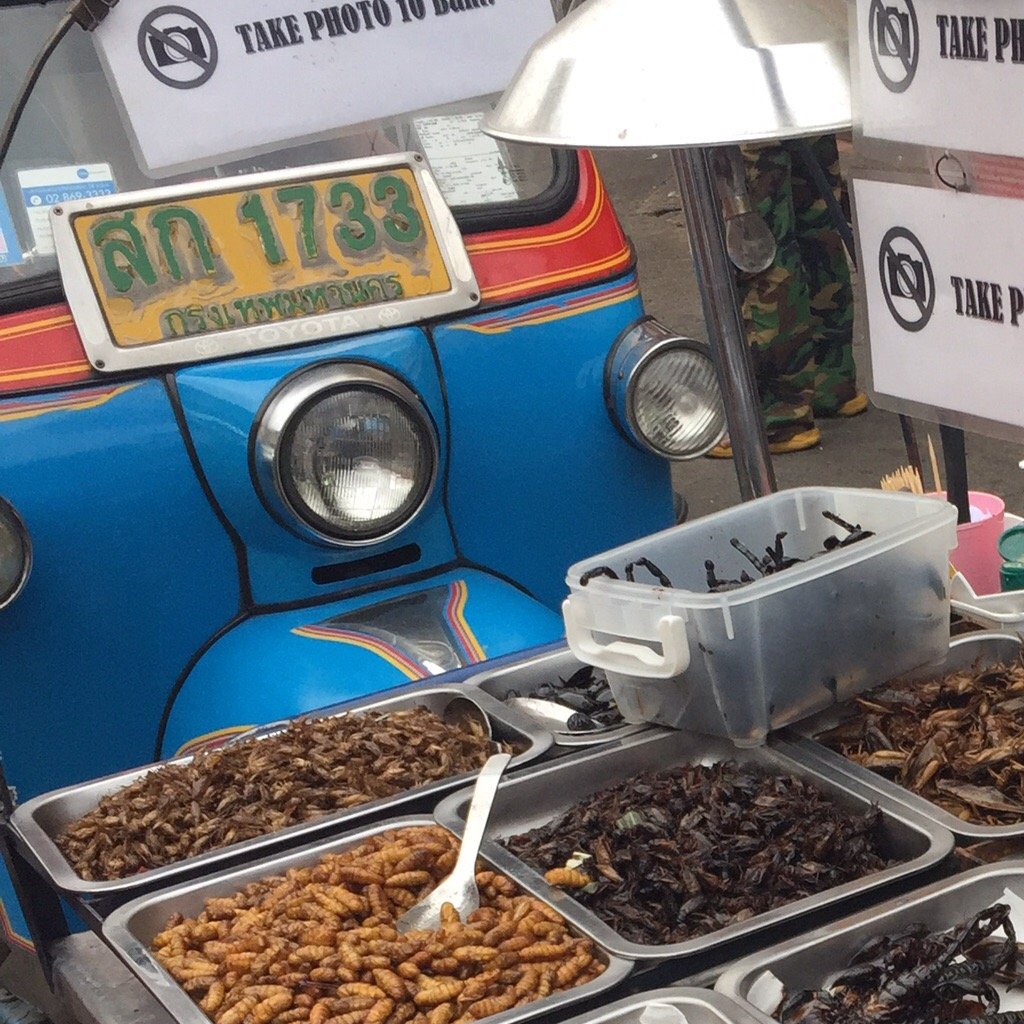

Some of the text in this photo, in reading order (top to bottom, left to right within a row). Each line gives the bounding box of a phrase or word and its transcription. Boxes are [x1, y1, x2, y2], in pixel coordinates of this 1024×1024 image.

[235, 14, 304, 54] TAKE
[303, 0, 392, 41] PHOTO
[396, 0, 426, 22] 10
[936, 14, 988, 62] TAKE
[94, 210, 215, 292] สก
[240, 175, 421, 265] 1733
[164, 274, 404, 337] กรงเทพมหานคร
[950, 275, 1004, 324] TAKE
[238, 313, 361, 347] TOYOTA
